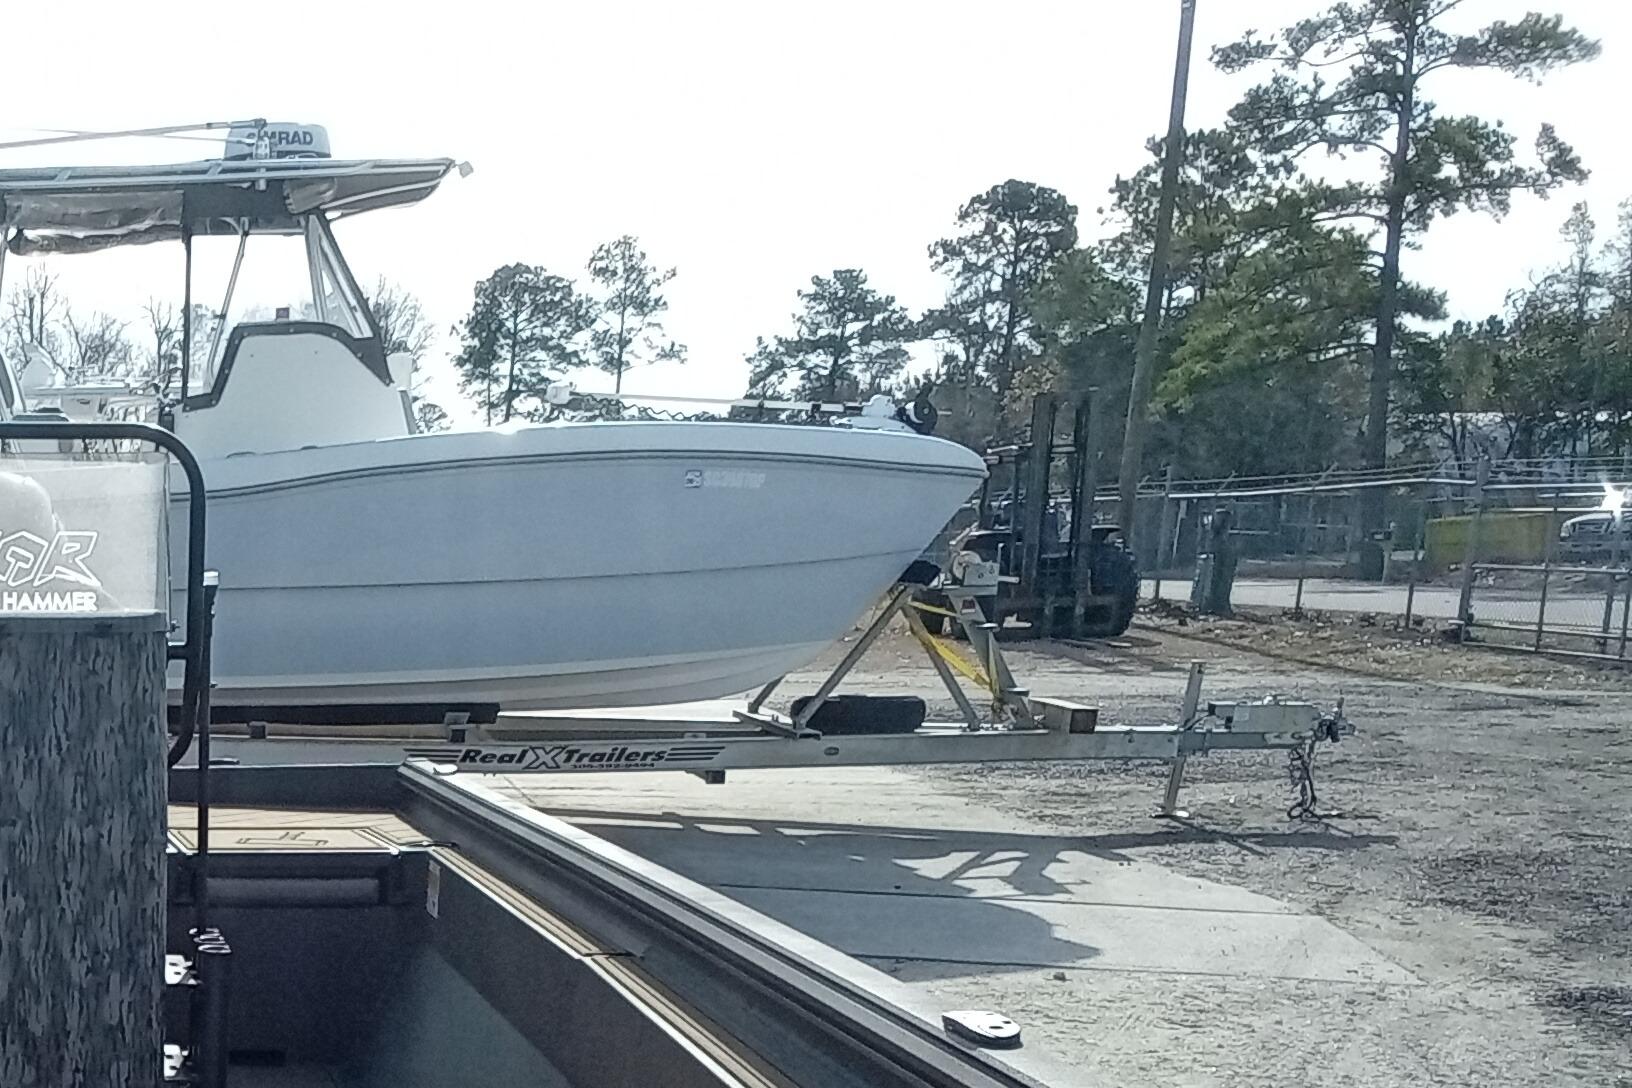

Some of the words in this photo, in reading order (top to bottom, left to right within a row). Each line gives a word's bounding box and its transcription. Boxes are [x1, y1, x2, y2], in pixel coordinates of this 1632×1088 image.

[2, 590, 98, 612] HAMMER
[458, 748, 529, 764] Real
[562, 747, 668, 764] Trailers
